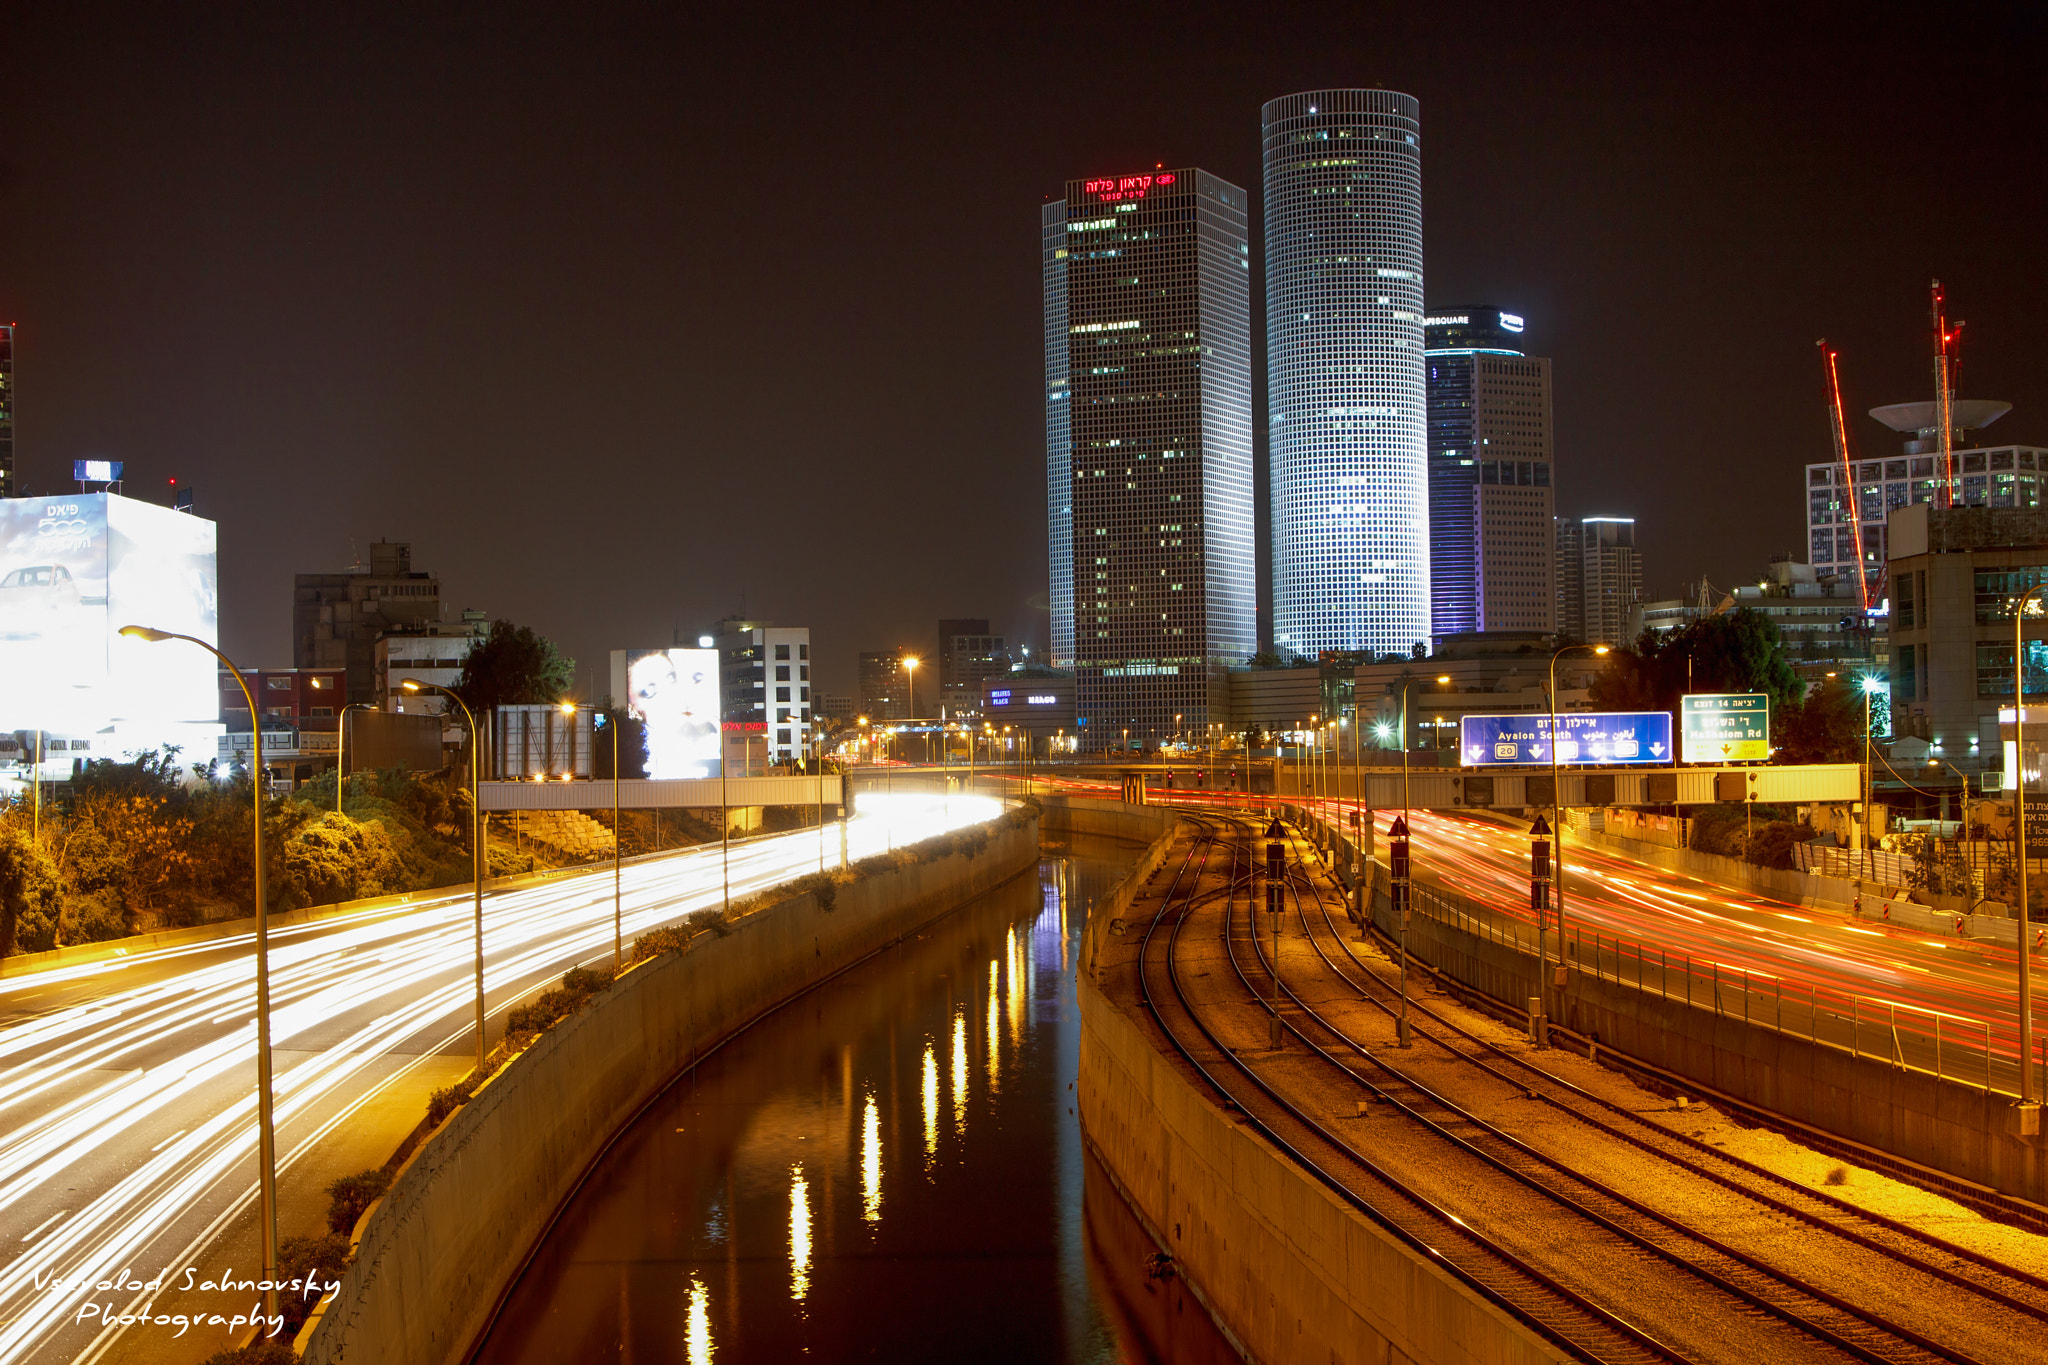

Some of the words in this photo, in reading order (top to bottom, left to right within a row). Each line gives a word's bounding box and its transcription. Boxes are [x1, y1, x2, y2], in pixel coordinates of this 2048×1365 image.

[1086, 178, 1114, 193] פלזה
[1120, 176, 1152, 192] קראון
[1099, 191, 1122, 201] סנטר
[1124, 190, 1144, 199] סיטי
[47, 504, 79, 517] פיאט
[38, 518, 88, 537] 500
[745, 722, 768, 731] דפוס
[1565, 718, 1597, 729] איילון
[1702, 717, 1735, 727] השלום
[1498, 731, 1535, 741] Ayalon
[1540, 731, 1572, 740] South
[1582, 732, 1608, 741] جنوب
[1690, 730, 1743, 739] HaShalom
[1747, 729, 1762, 738] Rd
[1500, 747, 1513, 755] 20
